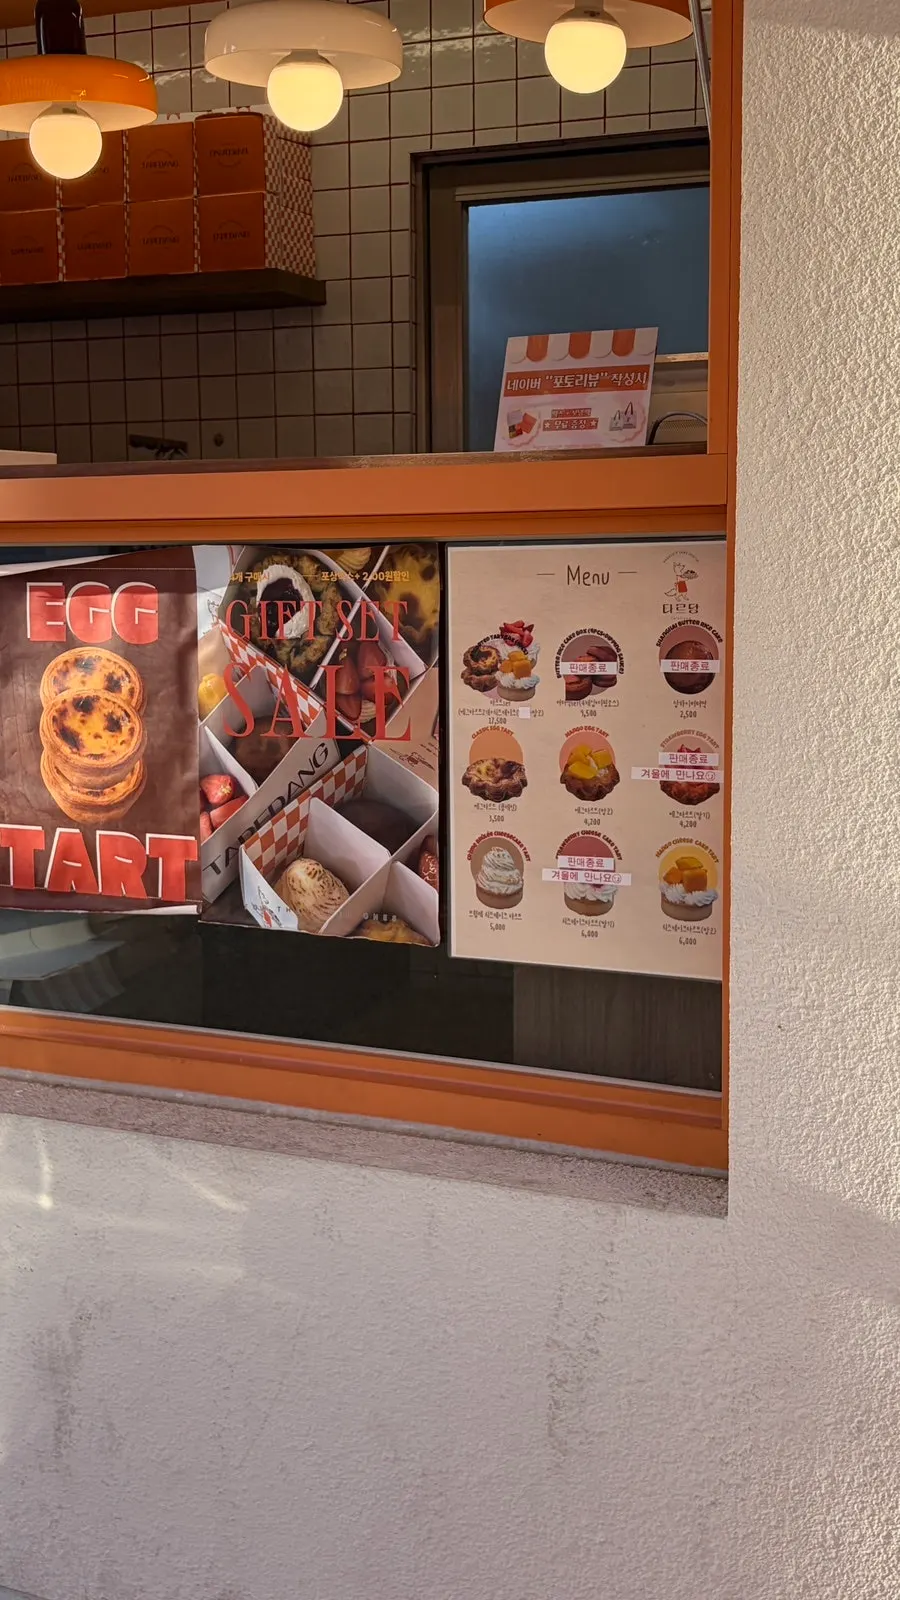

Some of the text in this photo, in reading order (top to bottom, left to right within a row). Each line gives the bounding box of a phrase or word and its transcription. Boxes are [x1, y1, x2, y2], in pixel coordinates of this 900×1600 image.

[506, 377, 541, 391] 네이버
[610, 371, 647, 387] 작성시
[567, 564, 610, 587] Menu
[26, 581, 159, 645] EGG
[225, 599, 408, 642] GIFT SET
[562, 632, 576, 644] CAKE
[699, 621, 713, 631] RICE
[710, 628, 723, 643] CAKE
[569, 663, 607, 673] 판매종료
[671, 661, 710, 672] 판매종료
[222, 662, 411, 741] SALE
[679, 710, 697, 719] 2,500
[488, 717, 507, 725] 17,500
[595, 727, 609, 738] TART
[695, 730, 707, 738] EGG
[705, 735, 720, 749] TART
[669, 753, 708, 764] 판매종료
[641, 768, 670, 779] 겨울에
[488, 814, 504, 823] 3,500
[580, 829, 602, 837] CHEESE
[601, 833, 616, 847] CAKE
[612, 845, 622, 860] TART
[521, 846, 530, 861] TART
[694, 839, 710, 850] CAKE
[707, 848, 719, 863] TART
[0, 823, 198, 902] TART
[567, 857, 605, 868] 판매종료
[552, 870, 579, 880] 겨울에
[490, 922, 505, 931] 5,000
